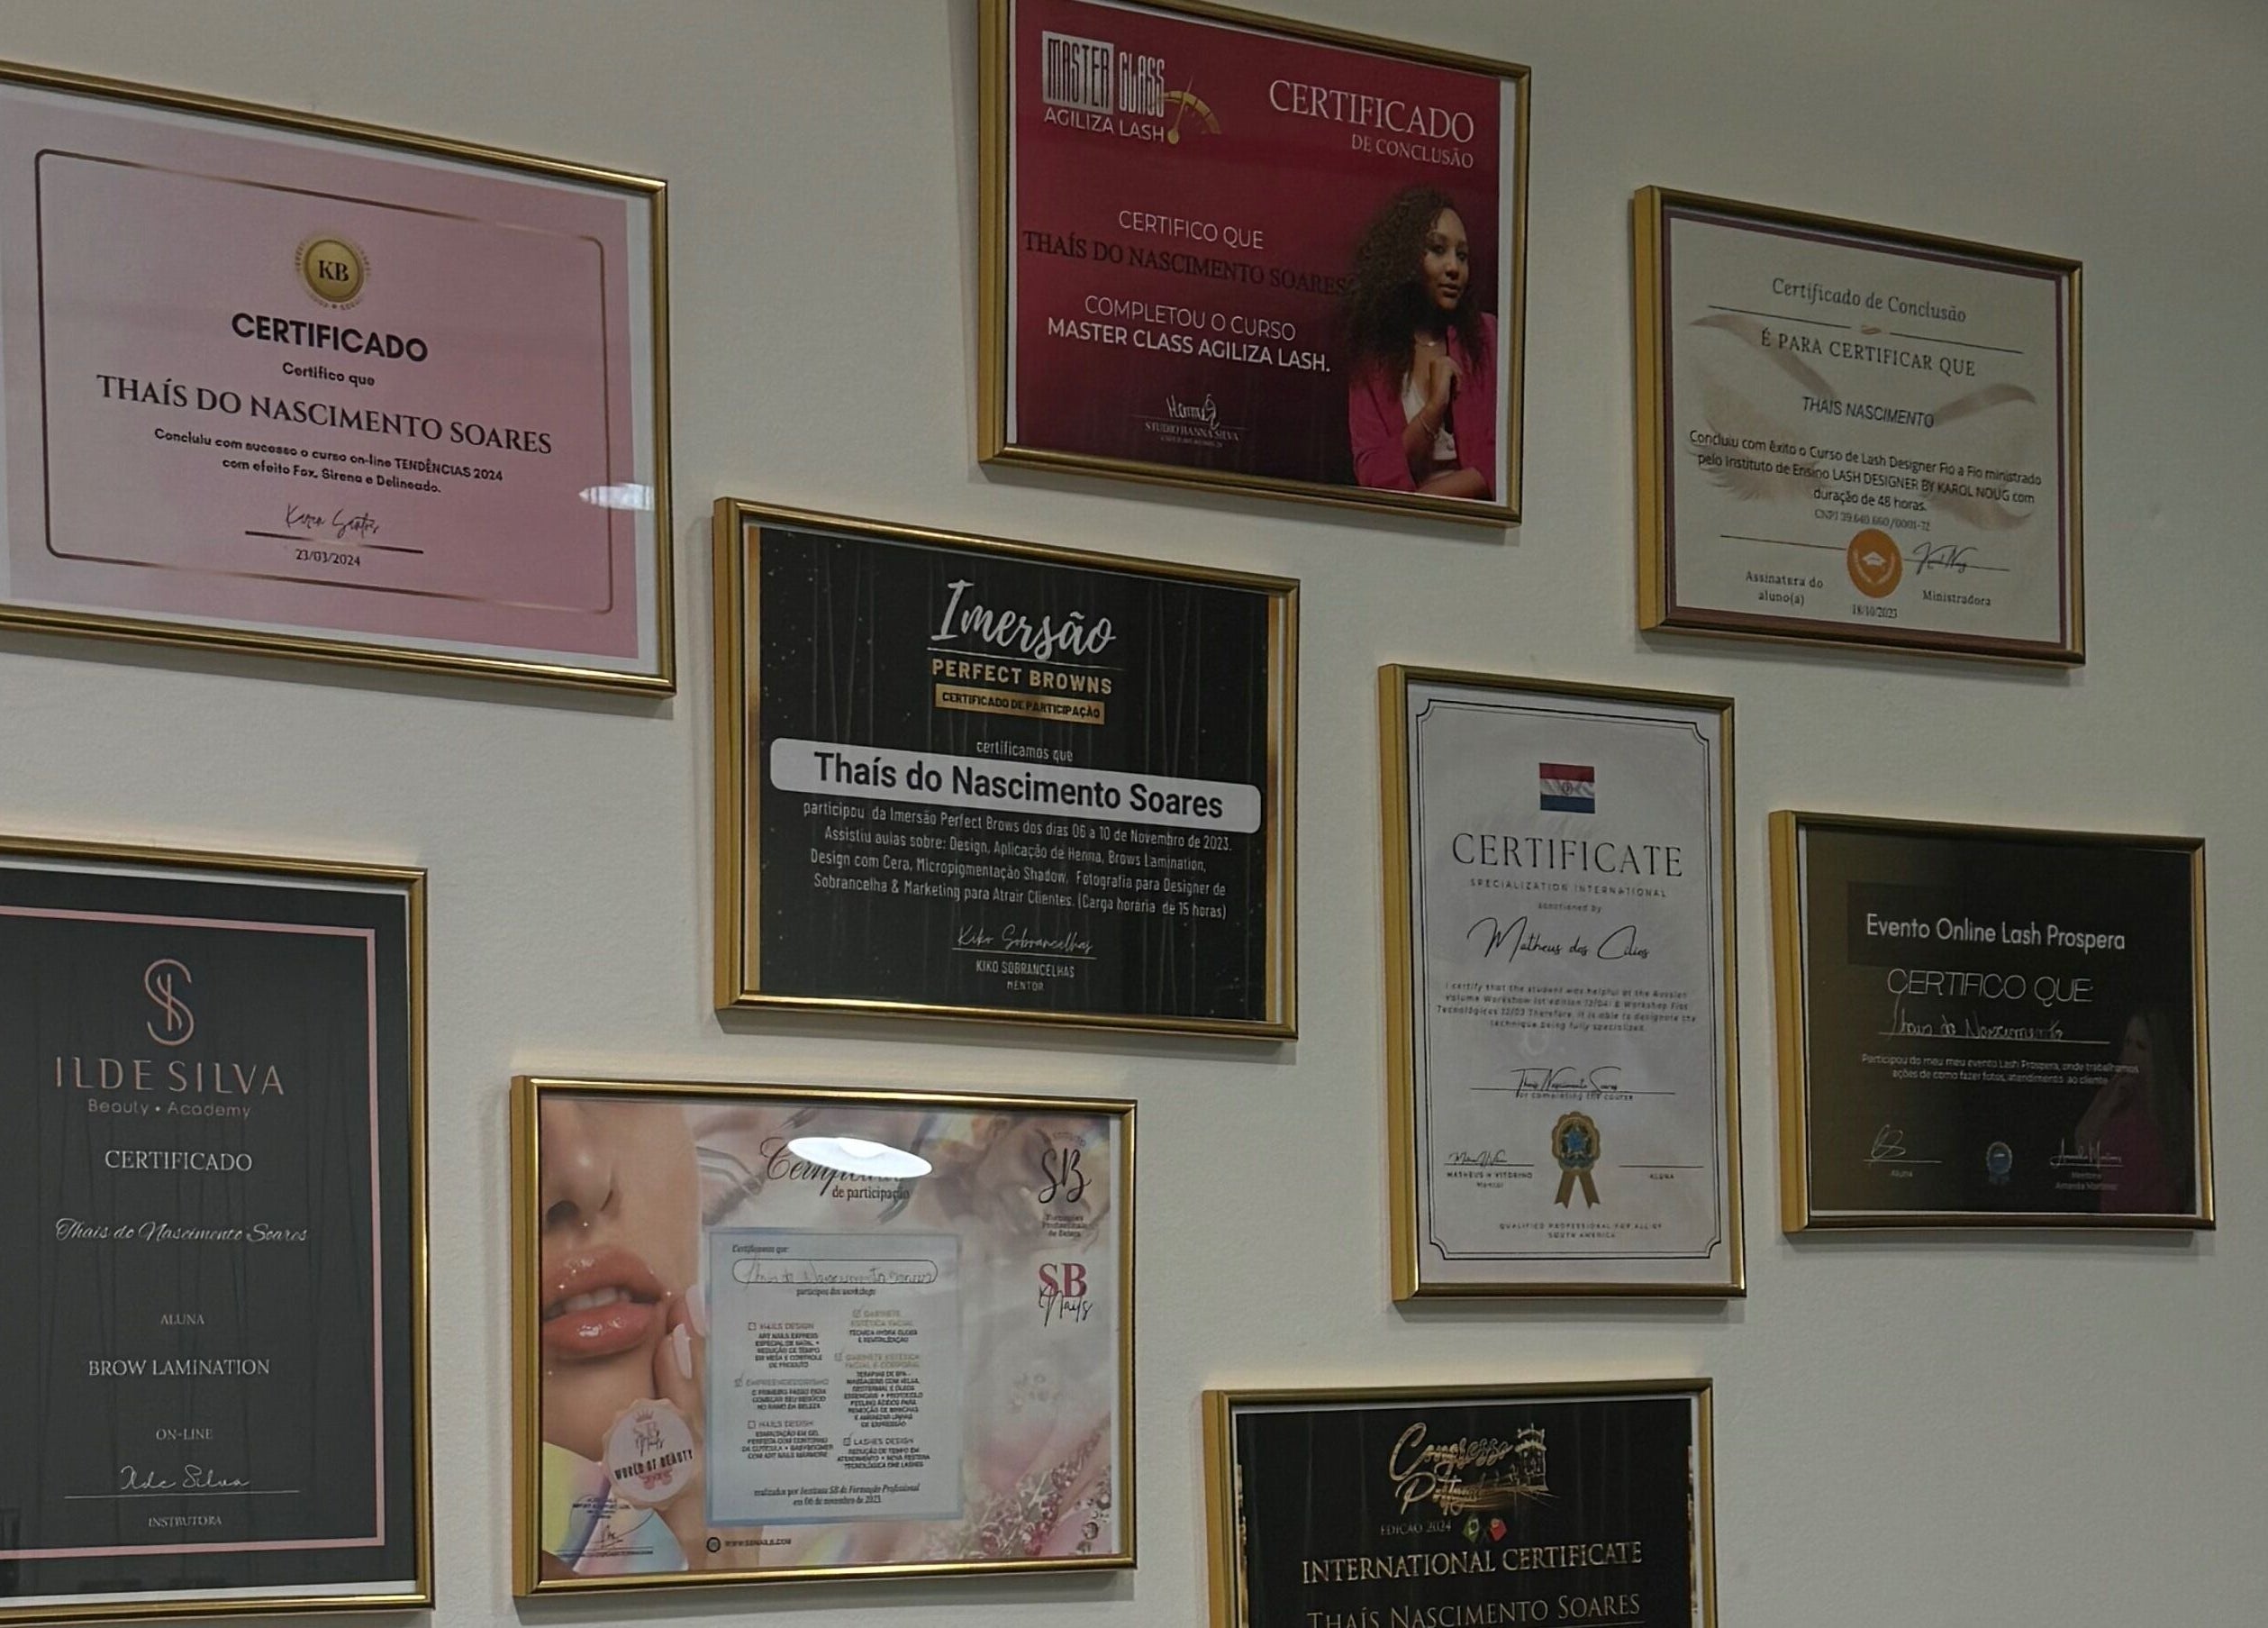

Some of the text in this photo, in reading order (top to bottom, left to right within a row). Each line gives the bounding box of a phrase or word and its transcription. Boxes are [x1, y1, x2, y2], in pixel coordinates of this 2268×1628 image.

[1044, 106, 1164, 142] AGILIZA LASH
[1269, 78, 1474, 143] CERTIFICADO
[1351, 133, 1473, 168] DE CONCLUSÃO
[1119, 210, 1263, 249] CERTIFICO QUE
[319, 259, 349, 282] KB
[1022, 229, 1347, 296] THAÍS DO NASCIMENTO SOARES
[1084, 295, 1295, 341] COMPLETOU O CURSO
[1772, 278, 1966, 323] Certificado de Conclusão
[231, 313, 427, 361] CERTIFICADO
[1048, 316, 1329, 372] MASTER CLASS AGILIZA LASH.
[1761, 329, 1974, 377] É PARA CERTIFICAR QUE
[282, 361, 375, 387] Certifico que
[96, 374, 551, 454] THAÍS DO NASCIMENTO SOARES
[1846, 403, 1934, 428] NASCIMENTO
[154, 428, 503, 481] Concluiu com sucesso o curso on-line TENDÊNCIAS 2024
[1799, 446, 1806, 456] o
[222, 459, 249, 469] com
[252, 459, 290, 474] efeito
[322, 468, 362, 483] Sirena
[365, 476, 373, 484] e
[376, 474, 440, 493] Delineado.
[295, 549, 360, 567] 23/03/2024
[1746, 570, 1823, 588] Assinatura do
[1922, 588, 1991, 606] Ministradora
[931, 579, 1116, 661] Imersão
[932, 658, 1111, 694] PERFECT BROWNS
[942, 692, 1100, 720] CERTIFICADO DE PARTICIPAÇÃO
[976, 741, 1073, 763] certificamos que
[813, 750, 1222, 818] Thaís do Nascimento Soares
[803, 803, 864, 820] participou
[872, 808, 885, 820] da
[890, 810, 936, 824] Imersão
[940, 814, 982, 829] Perfect
[986, 818, 1019, 832] Brows
[1022, 821, 1042, 834] dos
[1046, 823, 1068, 836] dias
[1088, 828, 1095, 839] a
[1100, 827, 1110, 841] 10
[1113, 829, 1127, 841] de
[1130, 830, 1184, 847] Novembro
[1187, 835, 1200, 848] de
[824, 827, 871, 843] Assistiu
[875, 832, 906, 846] aulas
[910, 835, 946, 849] sobre:
[993, 841, 1047, 859] Aplicação
[1050, 846, 1064, 859] de
[1108, 850, 1140, 866] Brows
[1144, 853, 1205, 872] Lamination,
[1452, 832, 1683, 878] CERTIFICATE
[1470, 878, 1665, 897] SPECIALIZATION INTERNATIONAL
[1867, 914, 2125, 953] Evento Online Lash Prospera
[975, 960, 1074, 978] KIKO SOBRANCELHAS
[1006, 979, 1045, 991] MENTOR
[1887, 968, 2092, 1005] CERTIFICO QUE
[54, 1056, 285, 1096] ILDE SILVA
[87, 1098, 251, 1119] Beauty Academy
[104, 1150, 253, 1172] CERTIFICADO
[832, 1185, 909, 1203] de participação
[113, 1224, 134, 1240] do
[138, 1221, 243, 1242] Nascimento
[246, 1223, 308, 1242] Soares
[1039, 1263, 1088, 1299] SB
[159, 1314, 205, 1326] ALUNA
[89, 1359, 268, 1376] BROW LAMINATION
[156, 1428, 213, 1442] ON-LINE
[148, 1515, 222, 1529] INSTRUTORA
[1302, 1541, 1641, 1584] INTERNATIONAL CERTIFICATE
[1306, 1594, 1641, 1628] THAÍS NASCIMENTO SOARES
